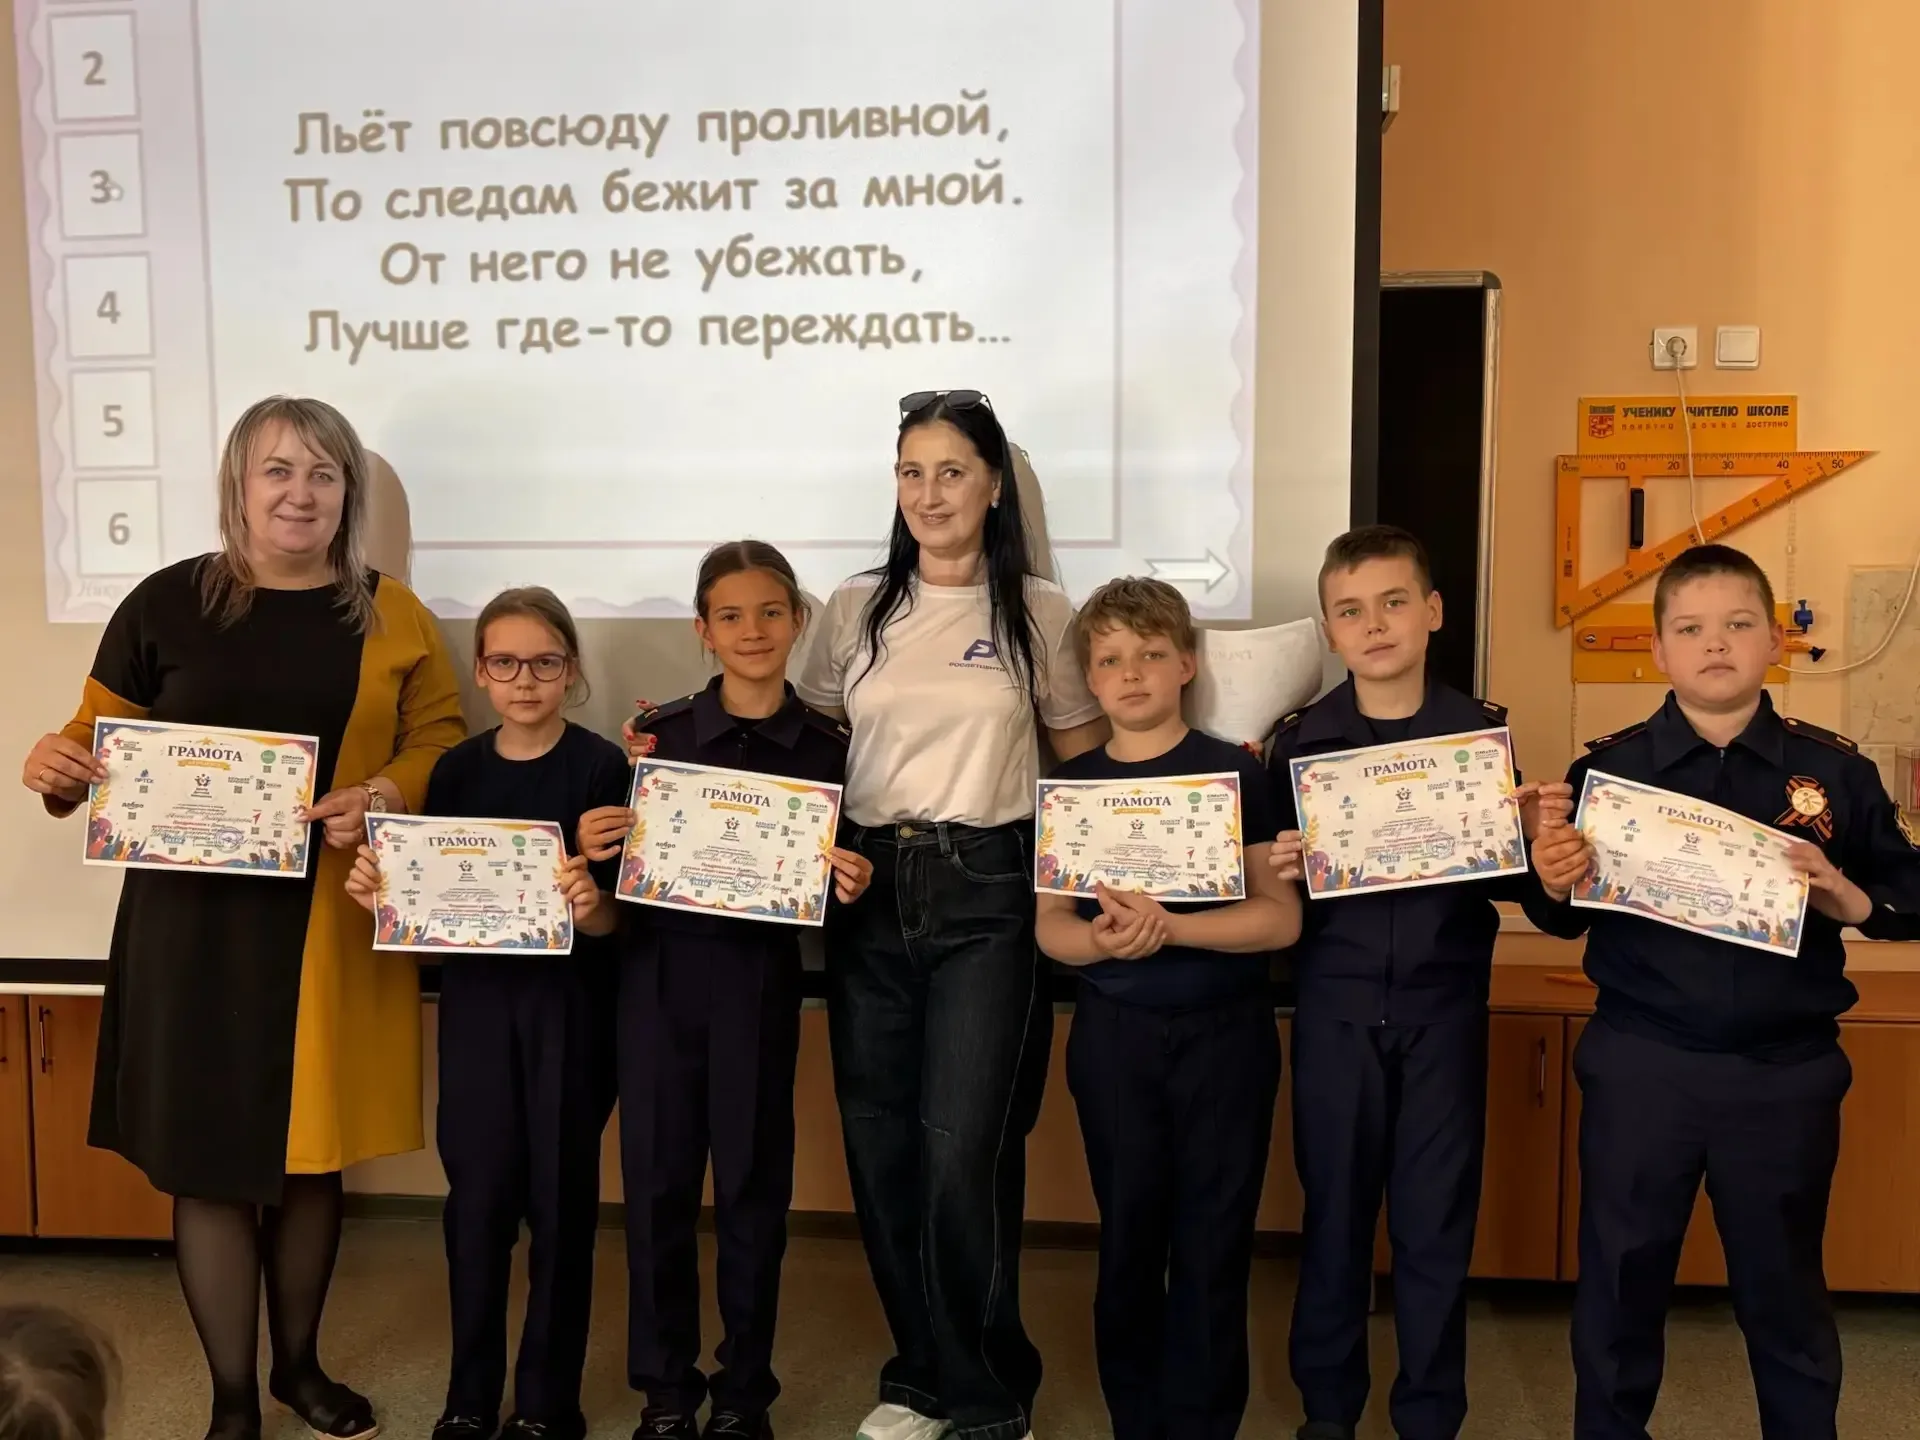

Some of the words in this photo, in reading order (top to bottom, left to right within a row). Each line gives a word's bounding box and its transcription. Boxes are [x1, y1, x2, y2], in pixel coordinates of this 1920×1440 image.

[82, 51, 106, 86] 2
[294, 109, 412, 155] Льёт
[440, 114, 669, 160] повсюду
[697, 89, 1009, 156] проливной,
[89, 170, 111, 204] 3
[283, 178, 362, 222] По
[385, 181, 577, 222] следам
[602, 168, 759, 213] бежит
[784, 176, 838, 210] за
[863, 158, 1024, 209] мной.
[380, 242, 446, 286] От
[469, 248, 587, 283] него
[610, 247, 670, 280] не
[694, 233, 923, 292] убежать,
[96, 290, 121, 325] 4
[304, 310, 470, 366] Лучше
[496, 314, 672, 354] где-то
[699, 312, 1012, 360] переждать...
[103, 404, 124, 438] 5
[1622, 406, 1676, 418] УЧЕНИКУ
[1747, 405, 1789, 417] ШКОЛЕ
[1615, 461, 1626, 471] 10
[1667, 461, 1680, 471] 20
[1721, 460, 1735, 470] 30
[1776, 460, 1789, 469] 40
[1831, 459, 1844, 469] 50
[108, 512, 131, 546] 6
[168, 745, 243, 762] ГРАМОТА
[1363, 757, 1438, 778] ГРАМОТА
[701, 787, 771, 808] ГРАМОТА
[1102, 796, 1172, 807] ГРАМОТА
[1657, 805, 1735, 833] ГРАМОТА
[428, 836, 497, 848] ГРАМОТА
